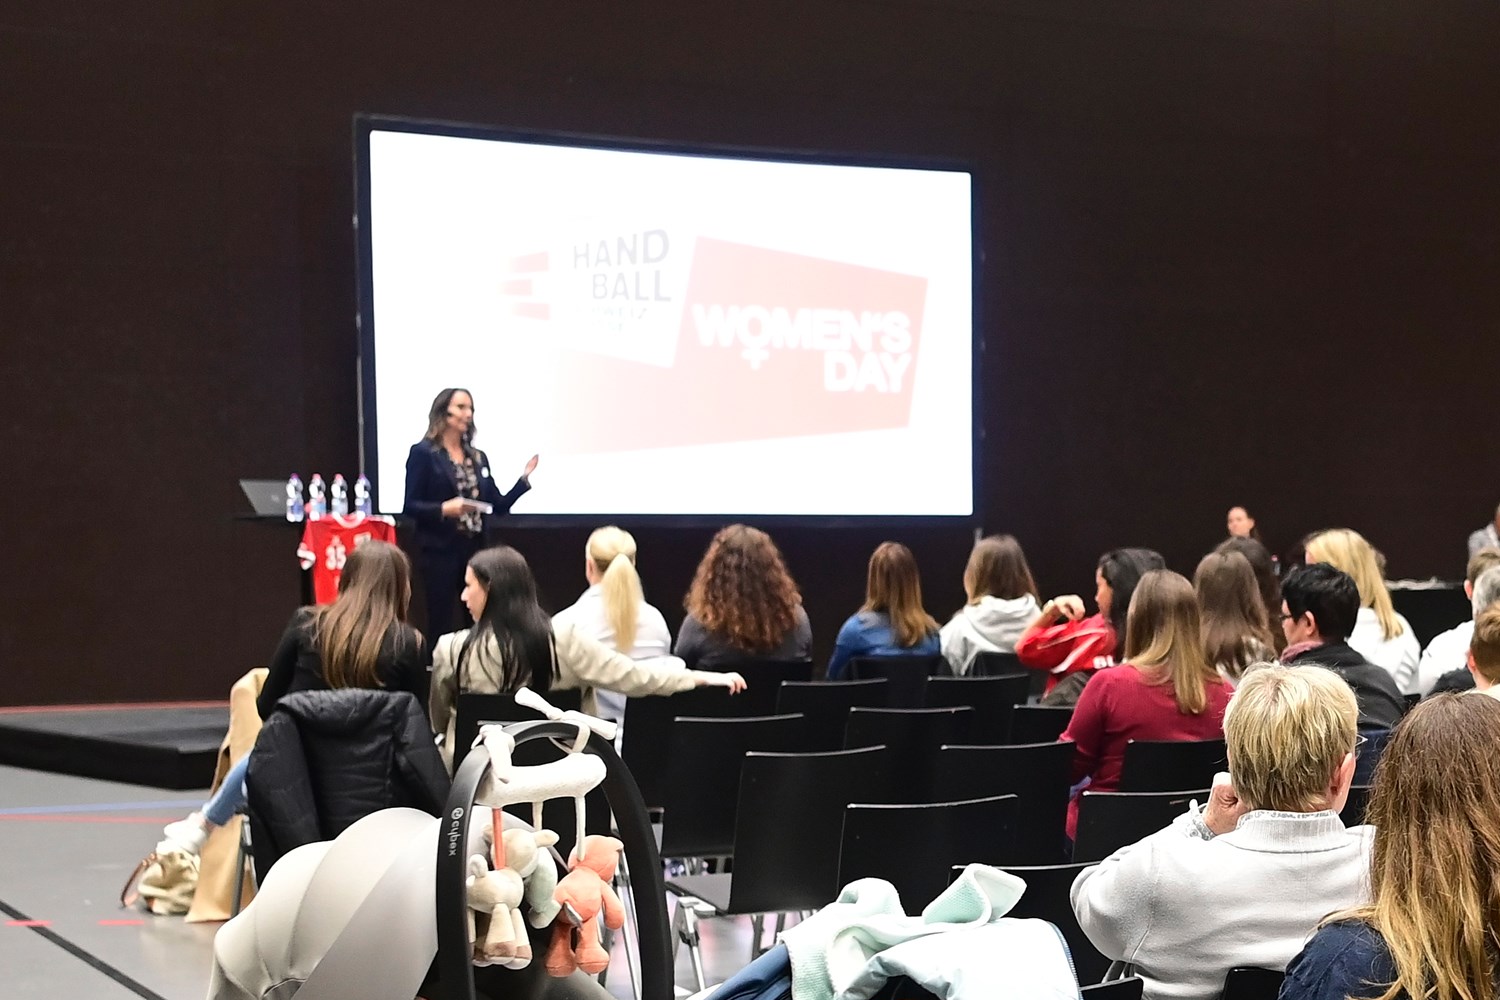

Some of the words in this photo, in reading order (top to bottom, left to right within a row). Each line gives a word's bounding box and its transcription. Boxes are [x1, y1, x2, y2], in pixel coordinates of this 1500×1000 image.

[573, 228, 670, 269] HAND
[592, 270, 672, 302] BALL
[692, 303, 912, 354] WOMEN'S
[824, 350, 912, 393] DAY
[447, 820, 461, 857] cybex
